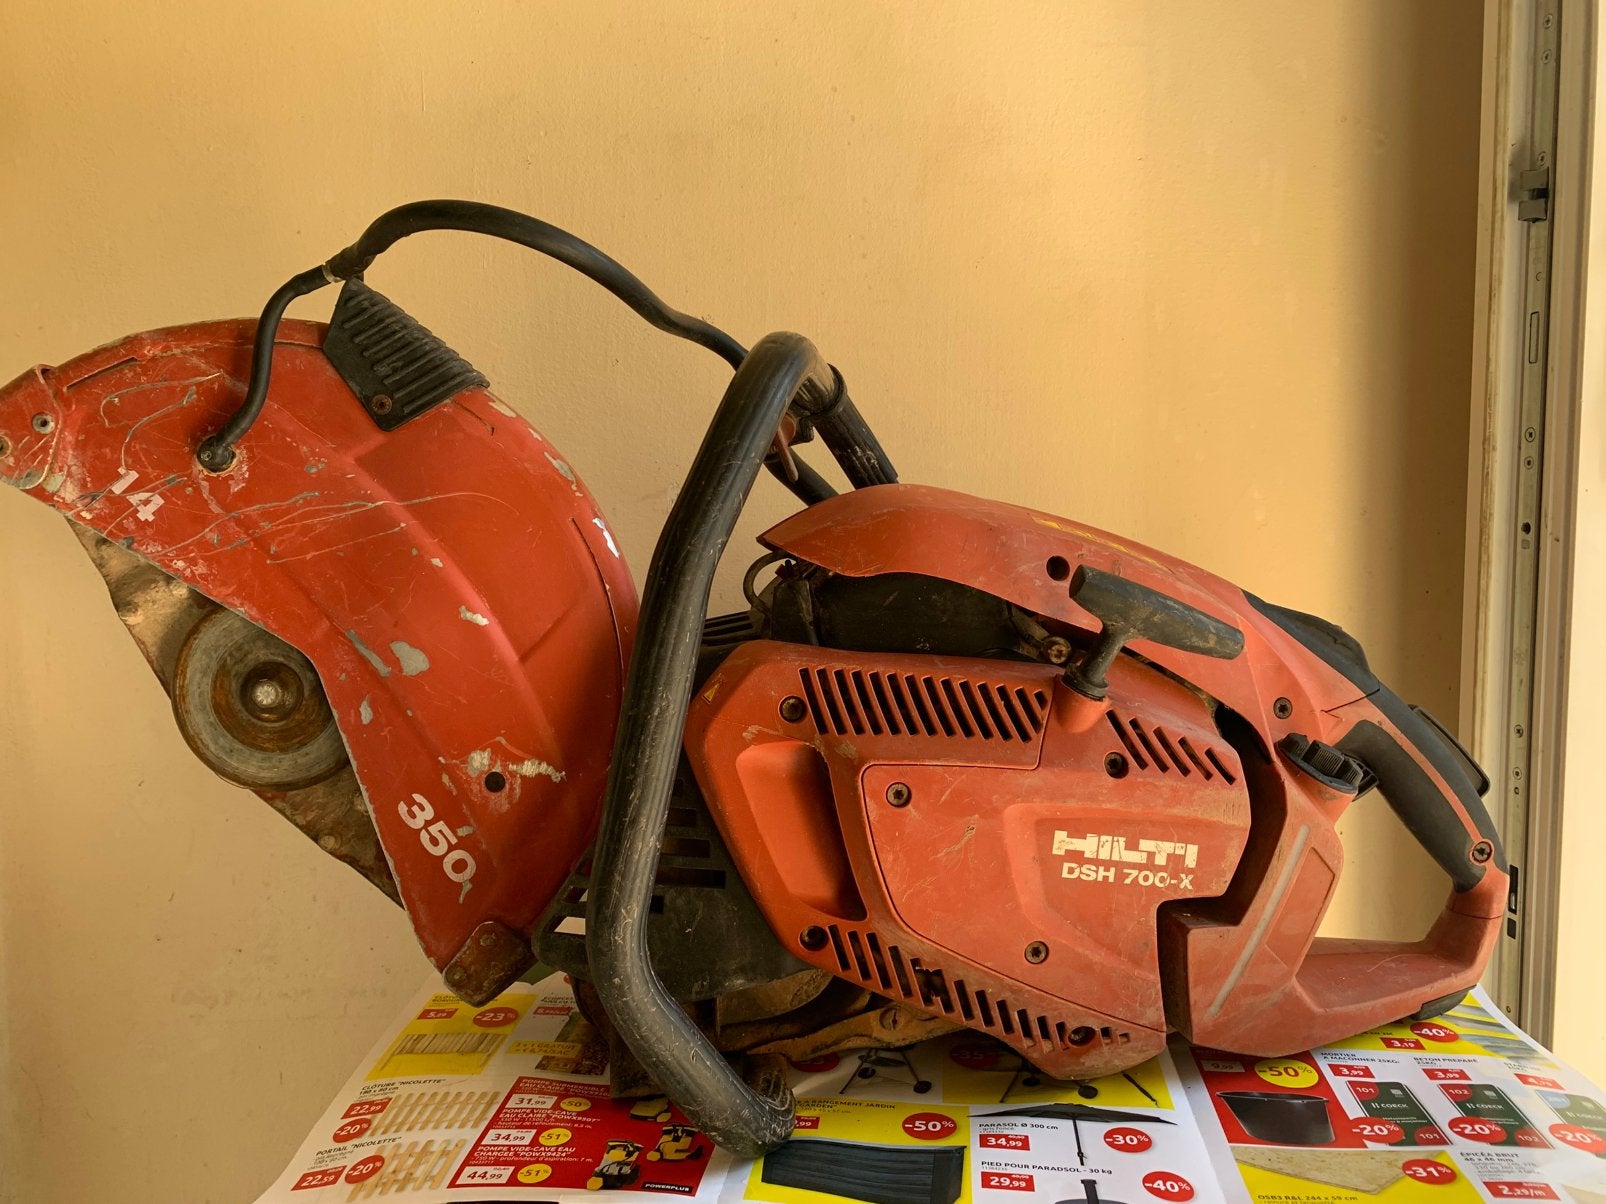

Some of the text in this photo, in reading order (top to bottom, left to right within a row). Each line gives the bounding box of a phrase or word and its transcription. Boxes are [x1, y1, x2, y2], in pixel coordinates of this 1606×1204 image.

[117, 465, 165, 522] 14
[397, 793, 477, 883] 350
[1052, 830, 1198, 868] HILTI
[1061, 862, 1194, 890] DSH 700-X
[1413, 1027, 1455, 1037] -40%
[1259, 1065, 1313, 1077] -50%
[1339, 1067, 1364, 1076] 3,99
[515, 1097, 547, 1106] 31,99
[351, 1104, 382, 1115] 22,99
[533, 1108, 578, 1116] VIDE-CAVE
[335, 1122, 369, 1136] -20%
[904, 1120, 954, 1132] -50%
[1351, 1124, 1400, 1136] -20%
[1453, 1123, 1502, 1135] -20%
[490, 1133, 526, 1142] 34,99
[986, 1137, 1023, 1148] 34,99
[1105, 1133, 1149, 1146] -30%
[1517, 1135, 1539, 1143] 102
[315, 1146, 348, 1157] PORTAIL
[351, 1136, 402, 1149] "NICOLETTE"
[348, 1160, 382, 1175] -20%
[520, 1169, 548, 1177] -51%
[1032, 1165, 1082, 1173] PARADSOL
[1405, 1165, 1452, 1178] -31%
[301, 1174, 335, 1187] 22,59
[467, 1170, 503, 1180] 44,99
[644, 1183, 690, 1192] POWERPLUS
[989, 1176, 1026, 1188] 29,99
[1144, 1179, 1191, 1194] -40%
